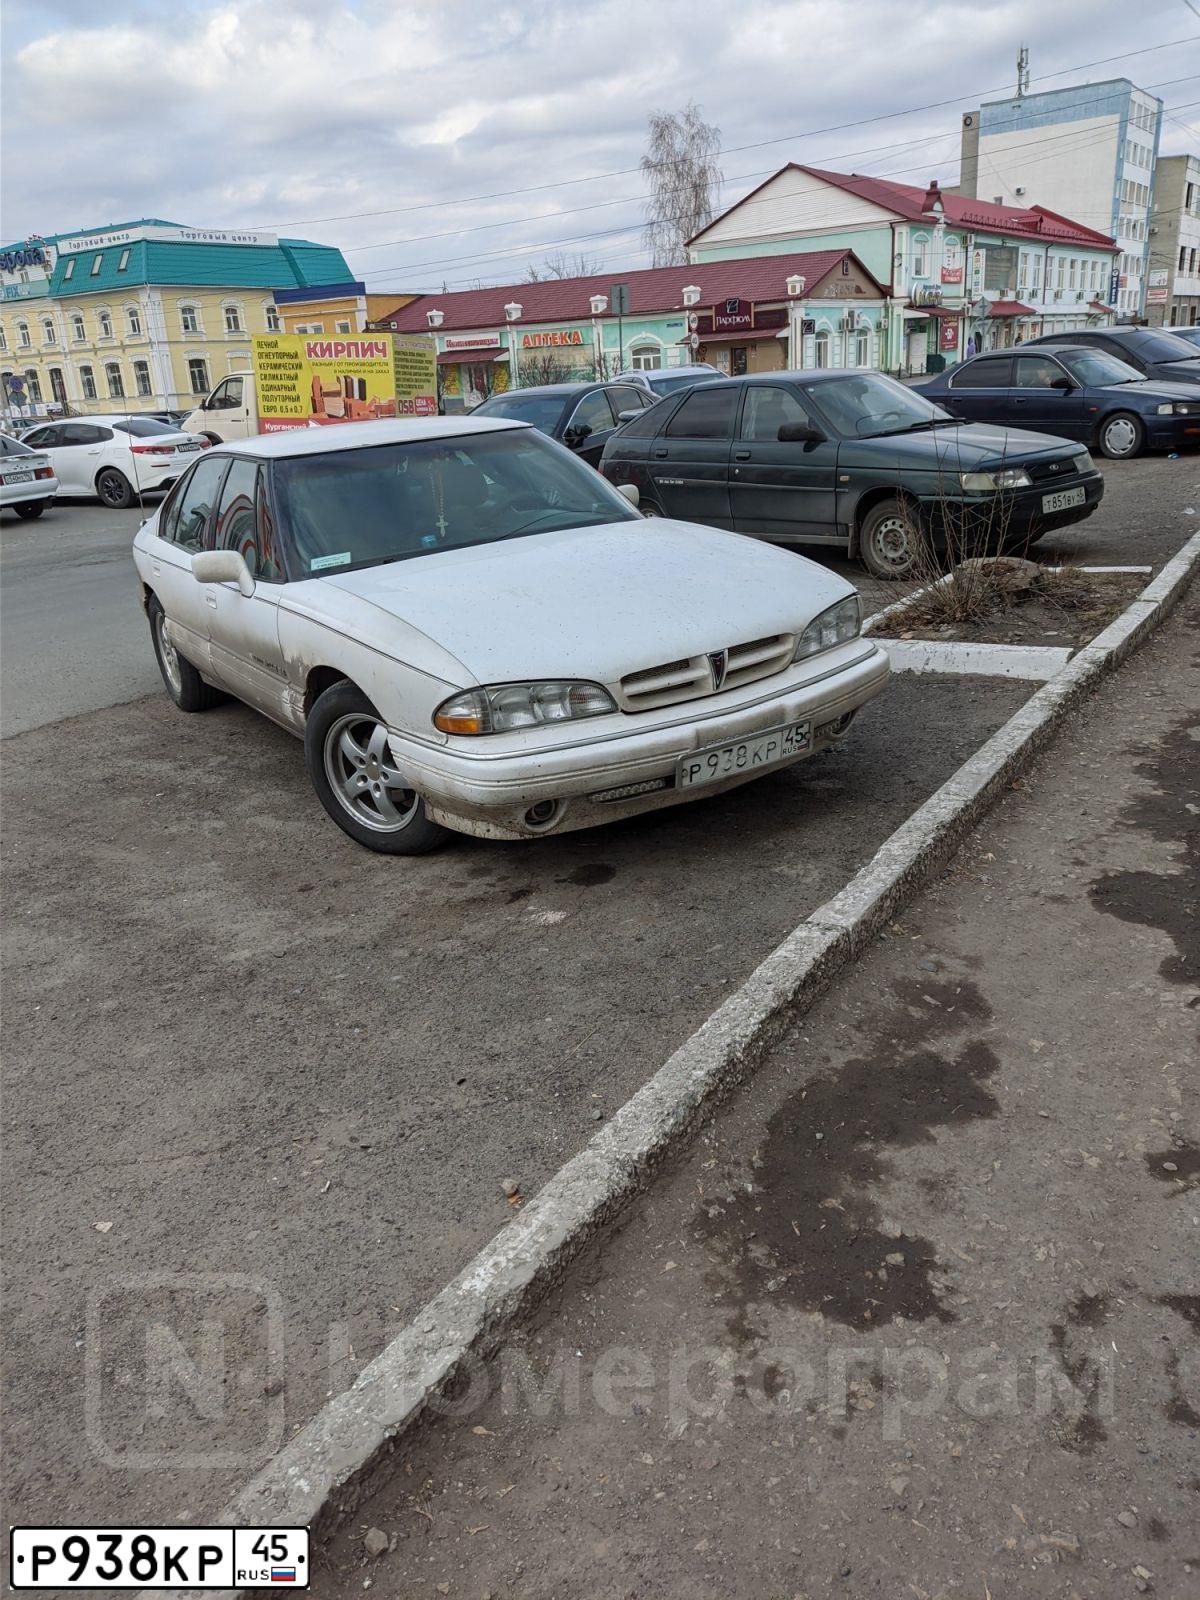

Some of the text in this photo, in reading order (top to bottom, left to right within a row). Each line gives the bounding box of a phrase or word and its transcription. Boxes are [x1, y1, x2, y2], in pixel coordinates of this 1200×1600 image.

[180, 230, 227, 241] Торговый
[68, 233, 130, 249] Торговый центр
[716, 315, 751, 326] ПАРФЮМ
[522, 330, 583, 347] АПТЕКА
[257, 340, 279, 349] ПЕЧНОЙ
[258, 350, 299, 360] ОГНЕУПОРНЫЙ
[306, 341, 387, 359] КИРПИЧ
[258, 361, 304, 371] КЕРАМИЧЕСКИЙ
[260, 372, 299, 381] СИЛИКАТНЫЙ
[261, 383, 297, 392] ОДИНАРНЫЙ
[262, 394, 301, 403] ПОЛУТОРНЫЙ
[263, 405, 278, 413] ЕВРО
[265, 423, 307, 432] Курганский
[689, 725, 805, 783] Р938КР 45
[782, 746, 798, 756] RUS
